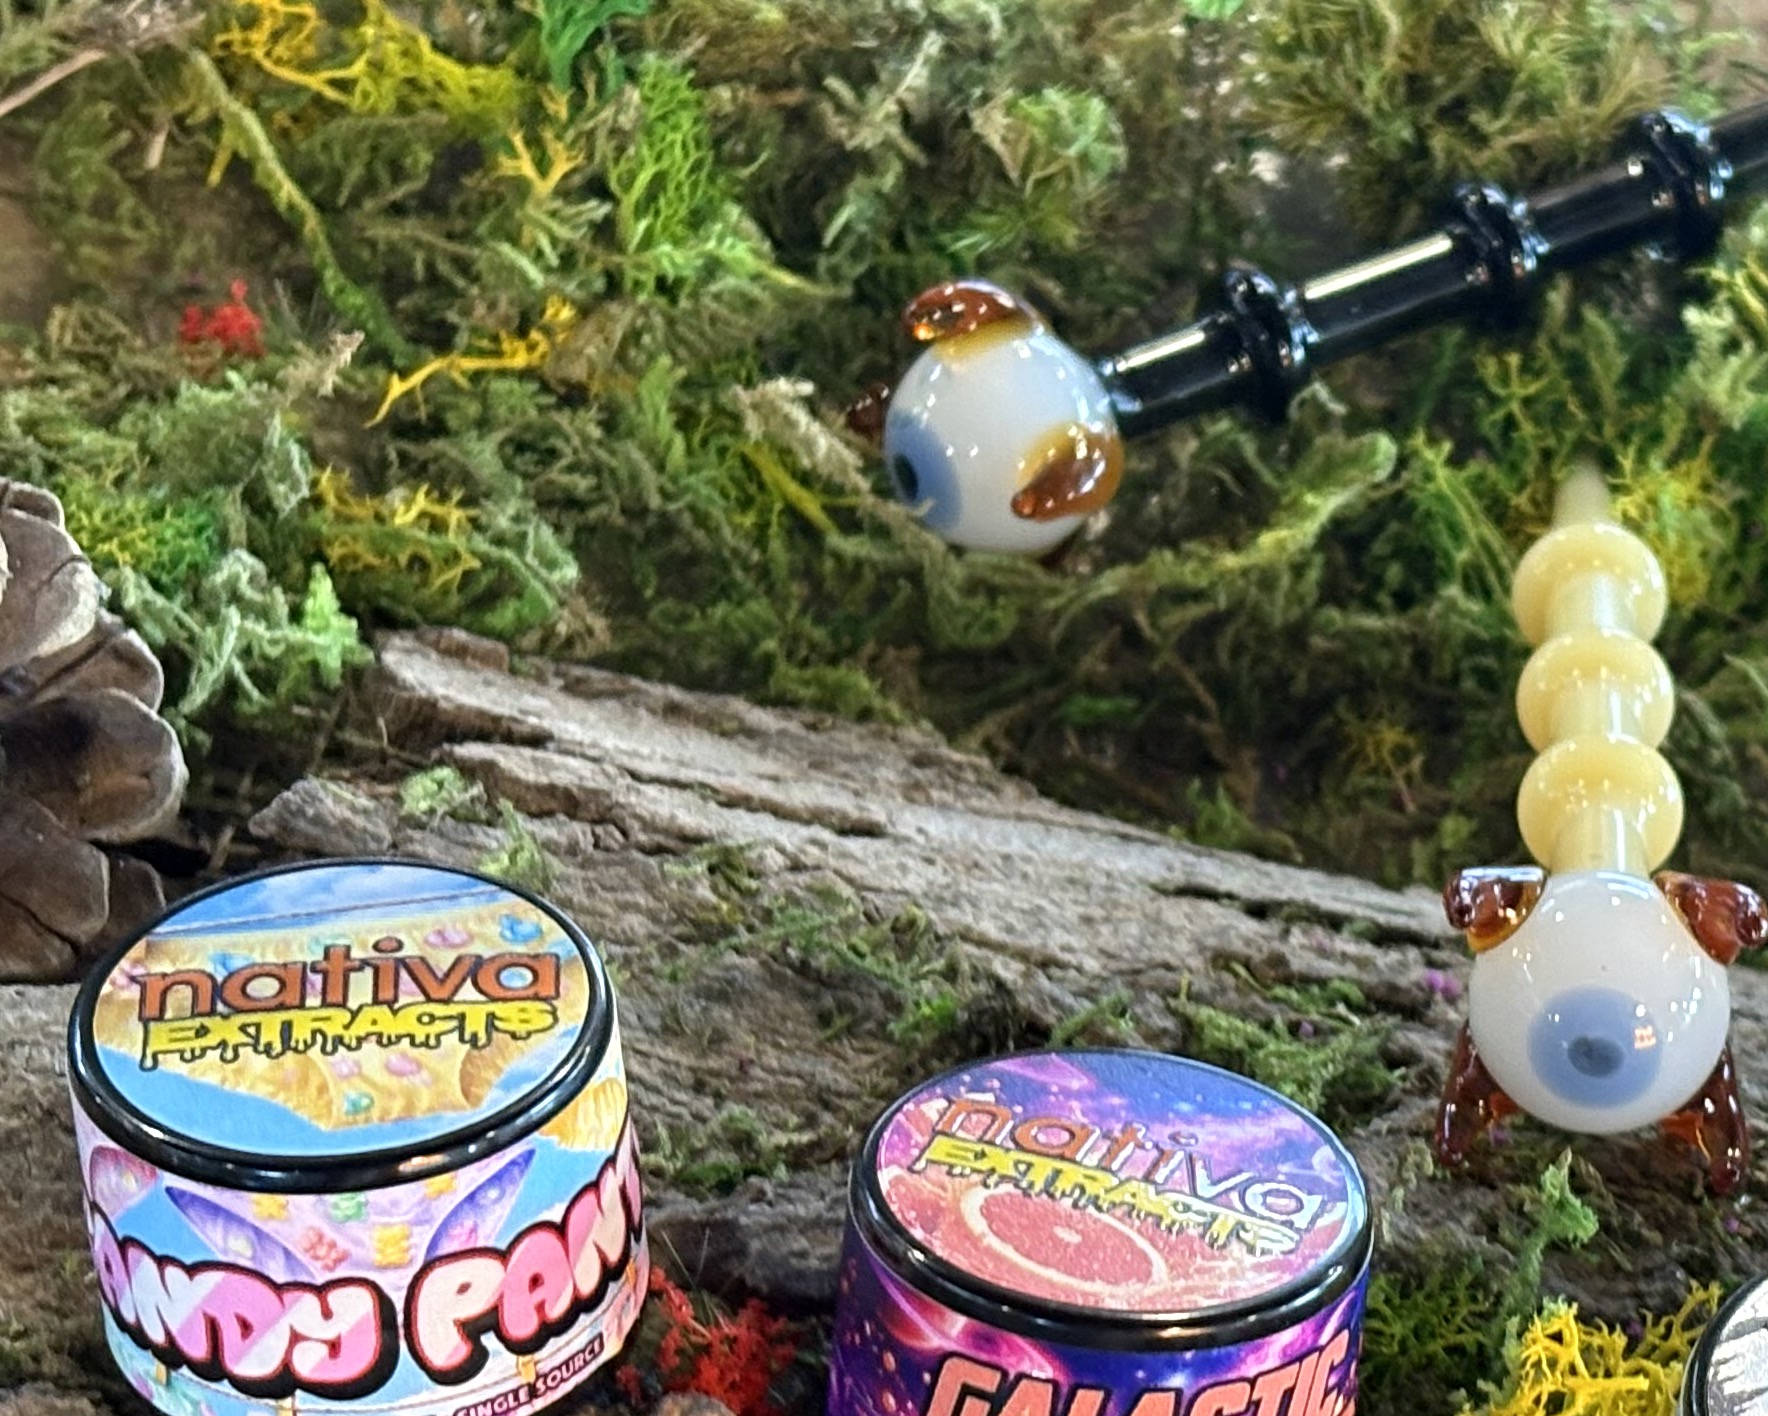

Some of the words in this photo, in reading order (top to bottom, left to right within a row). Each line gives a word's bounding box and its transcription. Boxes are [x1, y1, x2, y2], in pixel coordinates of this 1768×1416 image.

[139, 937, 562, 1022] nativa
[139, 999, 561, 1071] EXTRACTS
[908, 1133, 1300, 1257] EXTRACTS
[934, 1092, 1328, 1231] nativa
[533, 1337, 605, 1395] SOURCE
